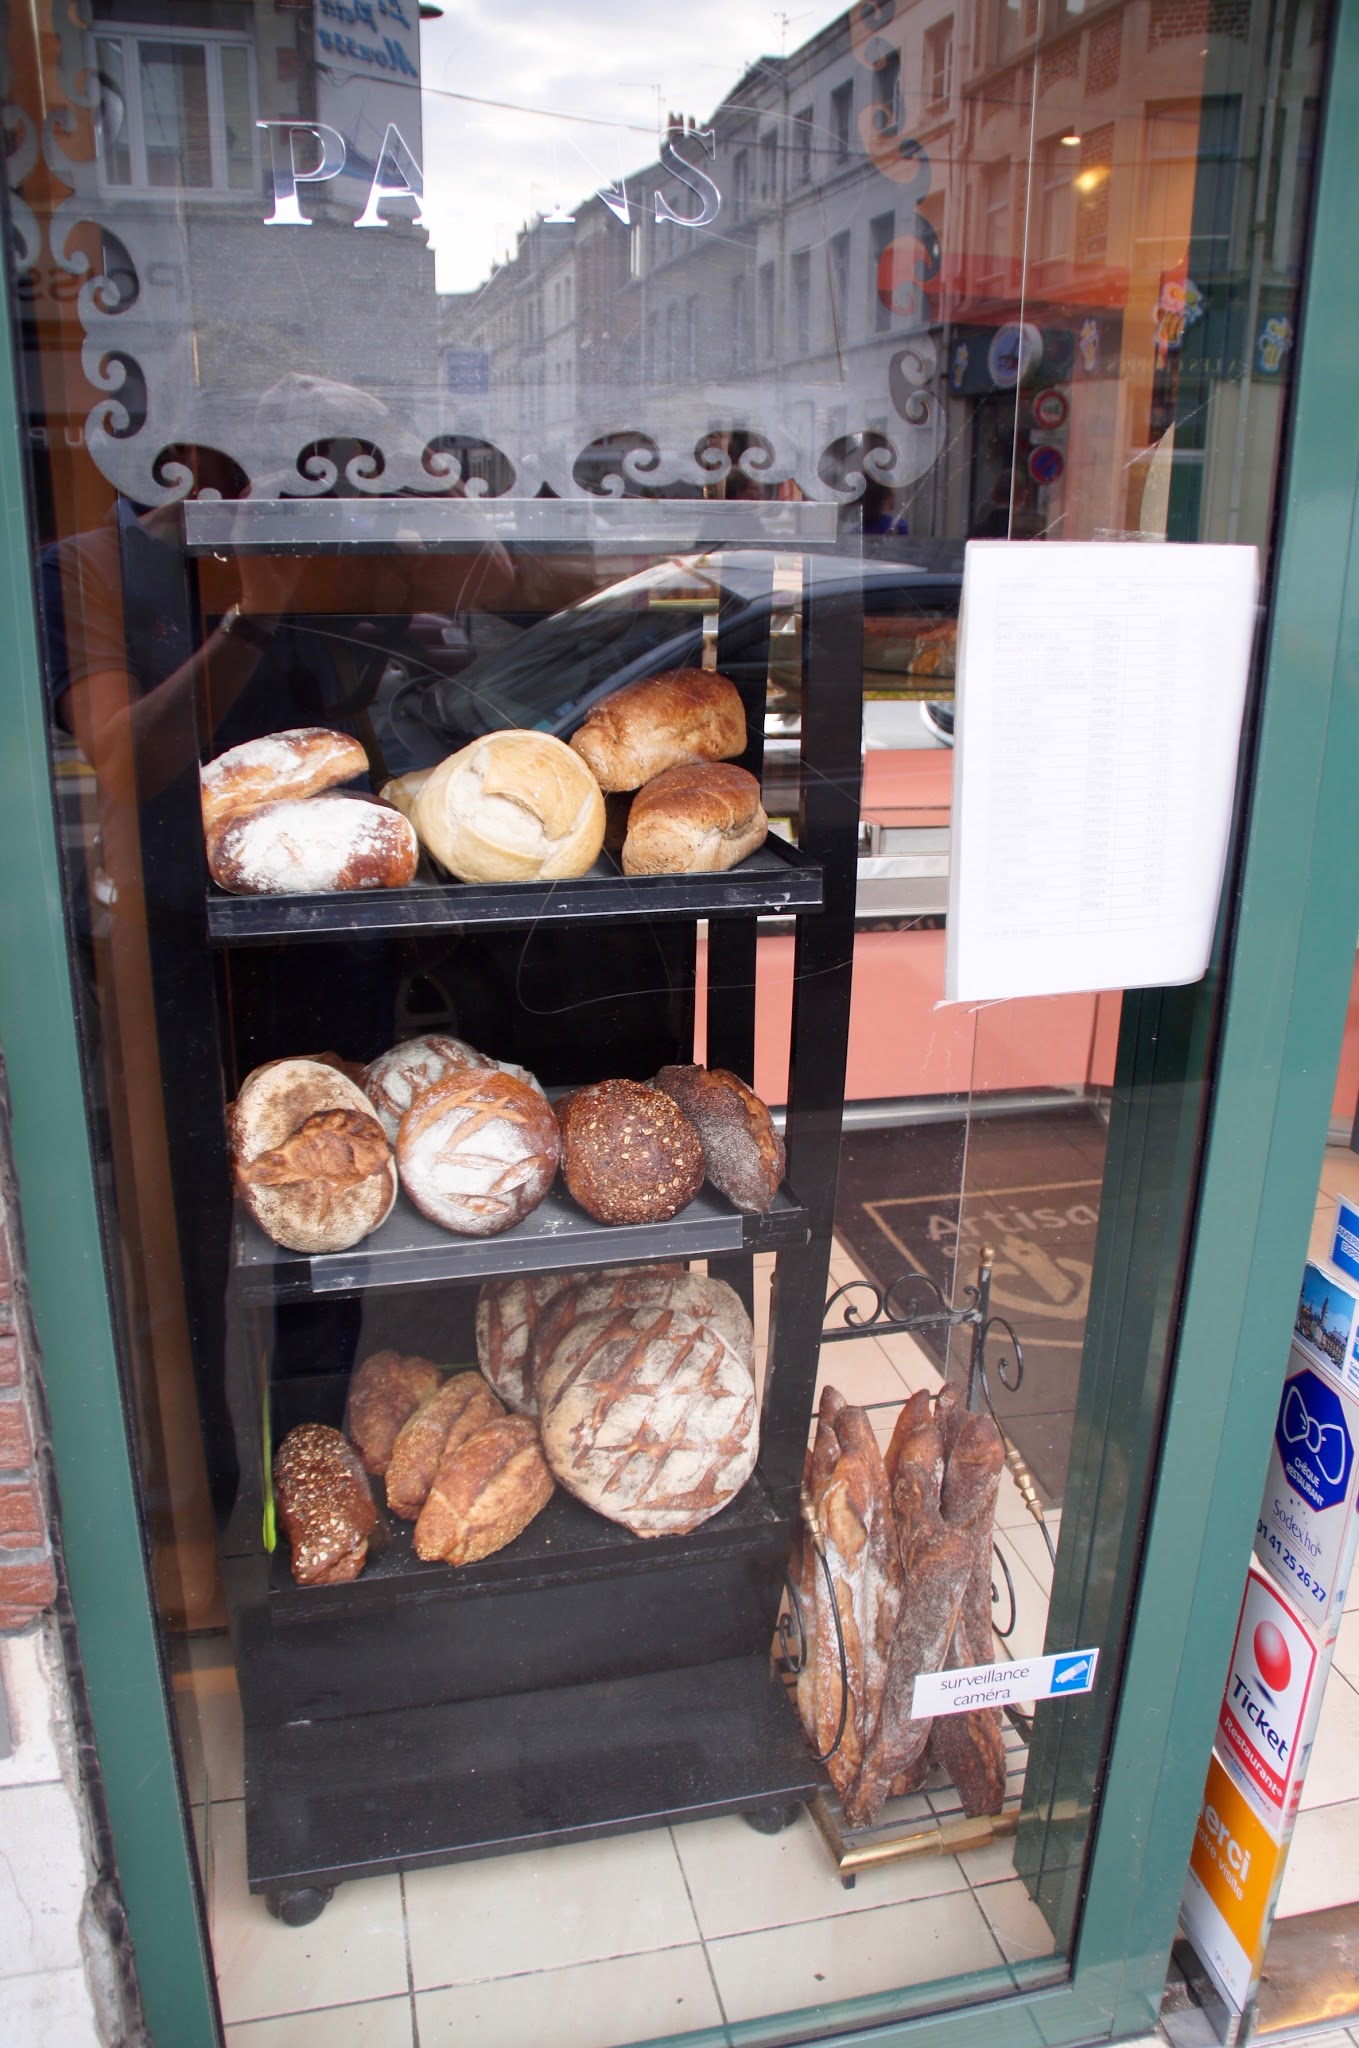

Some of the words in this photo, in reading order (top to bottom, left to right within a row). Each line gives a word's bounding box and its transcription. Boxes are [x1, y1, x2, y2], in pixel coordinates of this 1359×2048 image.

[256, 121, 721, 227] PANS
[1285, 1463, 1324, 1507] RESTAURANT
[1294, 1456, 1320, 1488] CHÈQUE
[1272, 1500, 1318, 1557] Sodexho
[1257, 1519, 1269, 1539] 01
[1269, 1533, 1282, 1555] 41
[1283, 1549, 1296, 1571] 25
[1297, 1564, 1311, 1587] 26
[1312, 1582, 1327, 1602] 27
[940, 1668, 1030, 1691] surveillance
[953, 1689, 1010, 1707] caméra
[1233, 1674, 1288, 1762] Ticket
[1200, 1800, 1250, 1883] erci
[1219, 1858, 1243, 1901] visite
